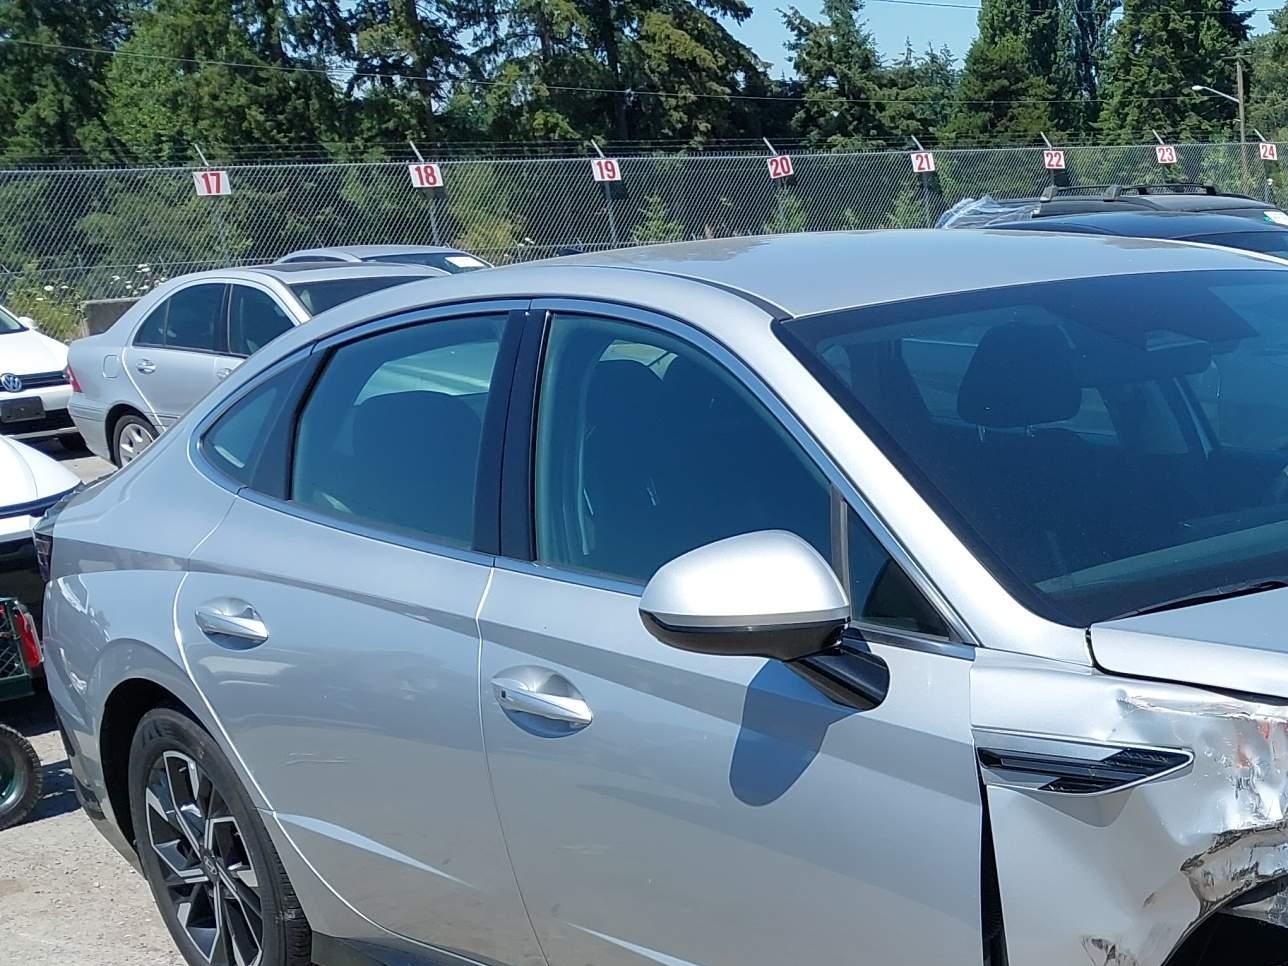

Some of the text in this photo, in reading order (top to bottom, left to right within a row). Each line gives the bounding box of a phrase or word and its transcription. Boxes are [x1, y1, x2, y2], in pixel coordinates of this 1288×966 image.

[1046, 152, 1063, 167] 22
[1158, 146, 1174, 162] 23
[1261, 144, 1275, 158] 24
[597, 160, 616, 179] 19
[770, 157, 791, 177] 20
[917, 153, 932, 170] 21
[202, 173, 222, 193] 17
[415, 165, 437, 186] 18
